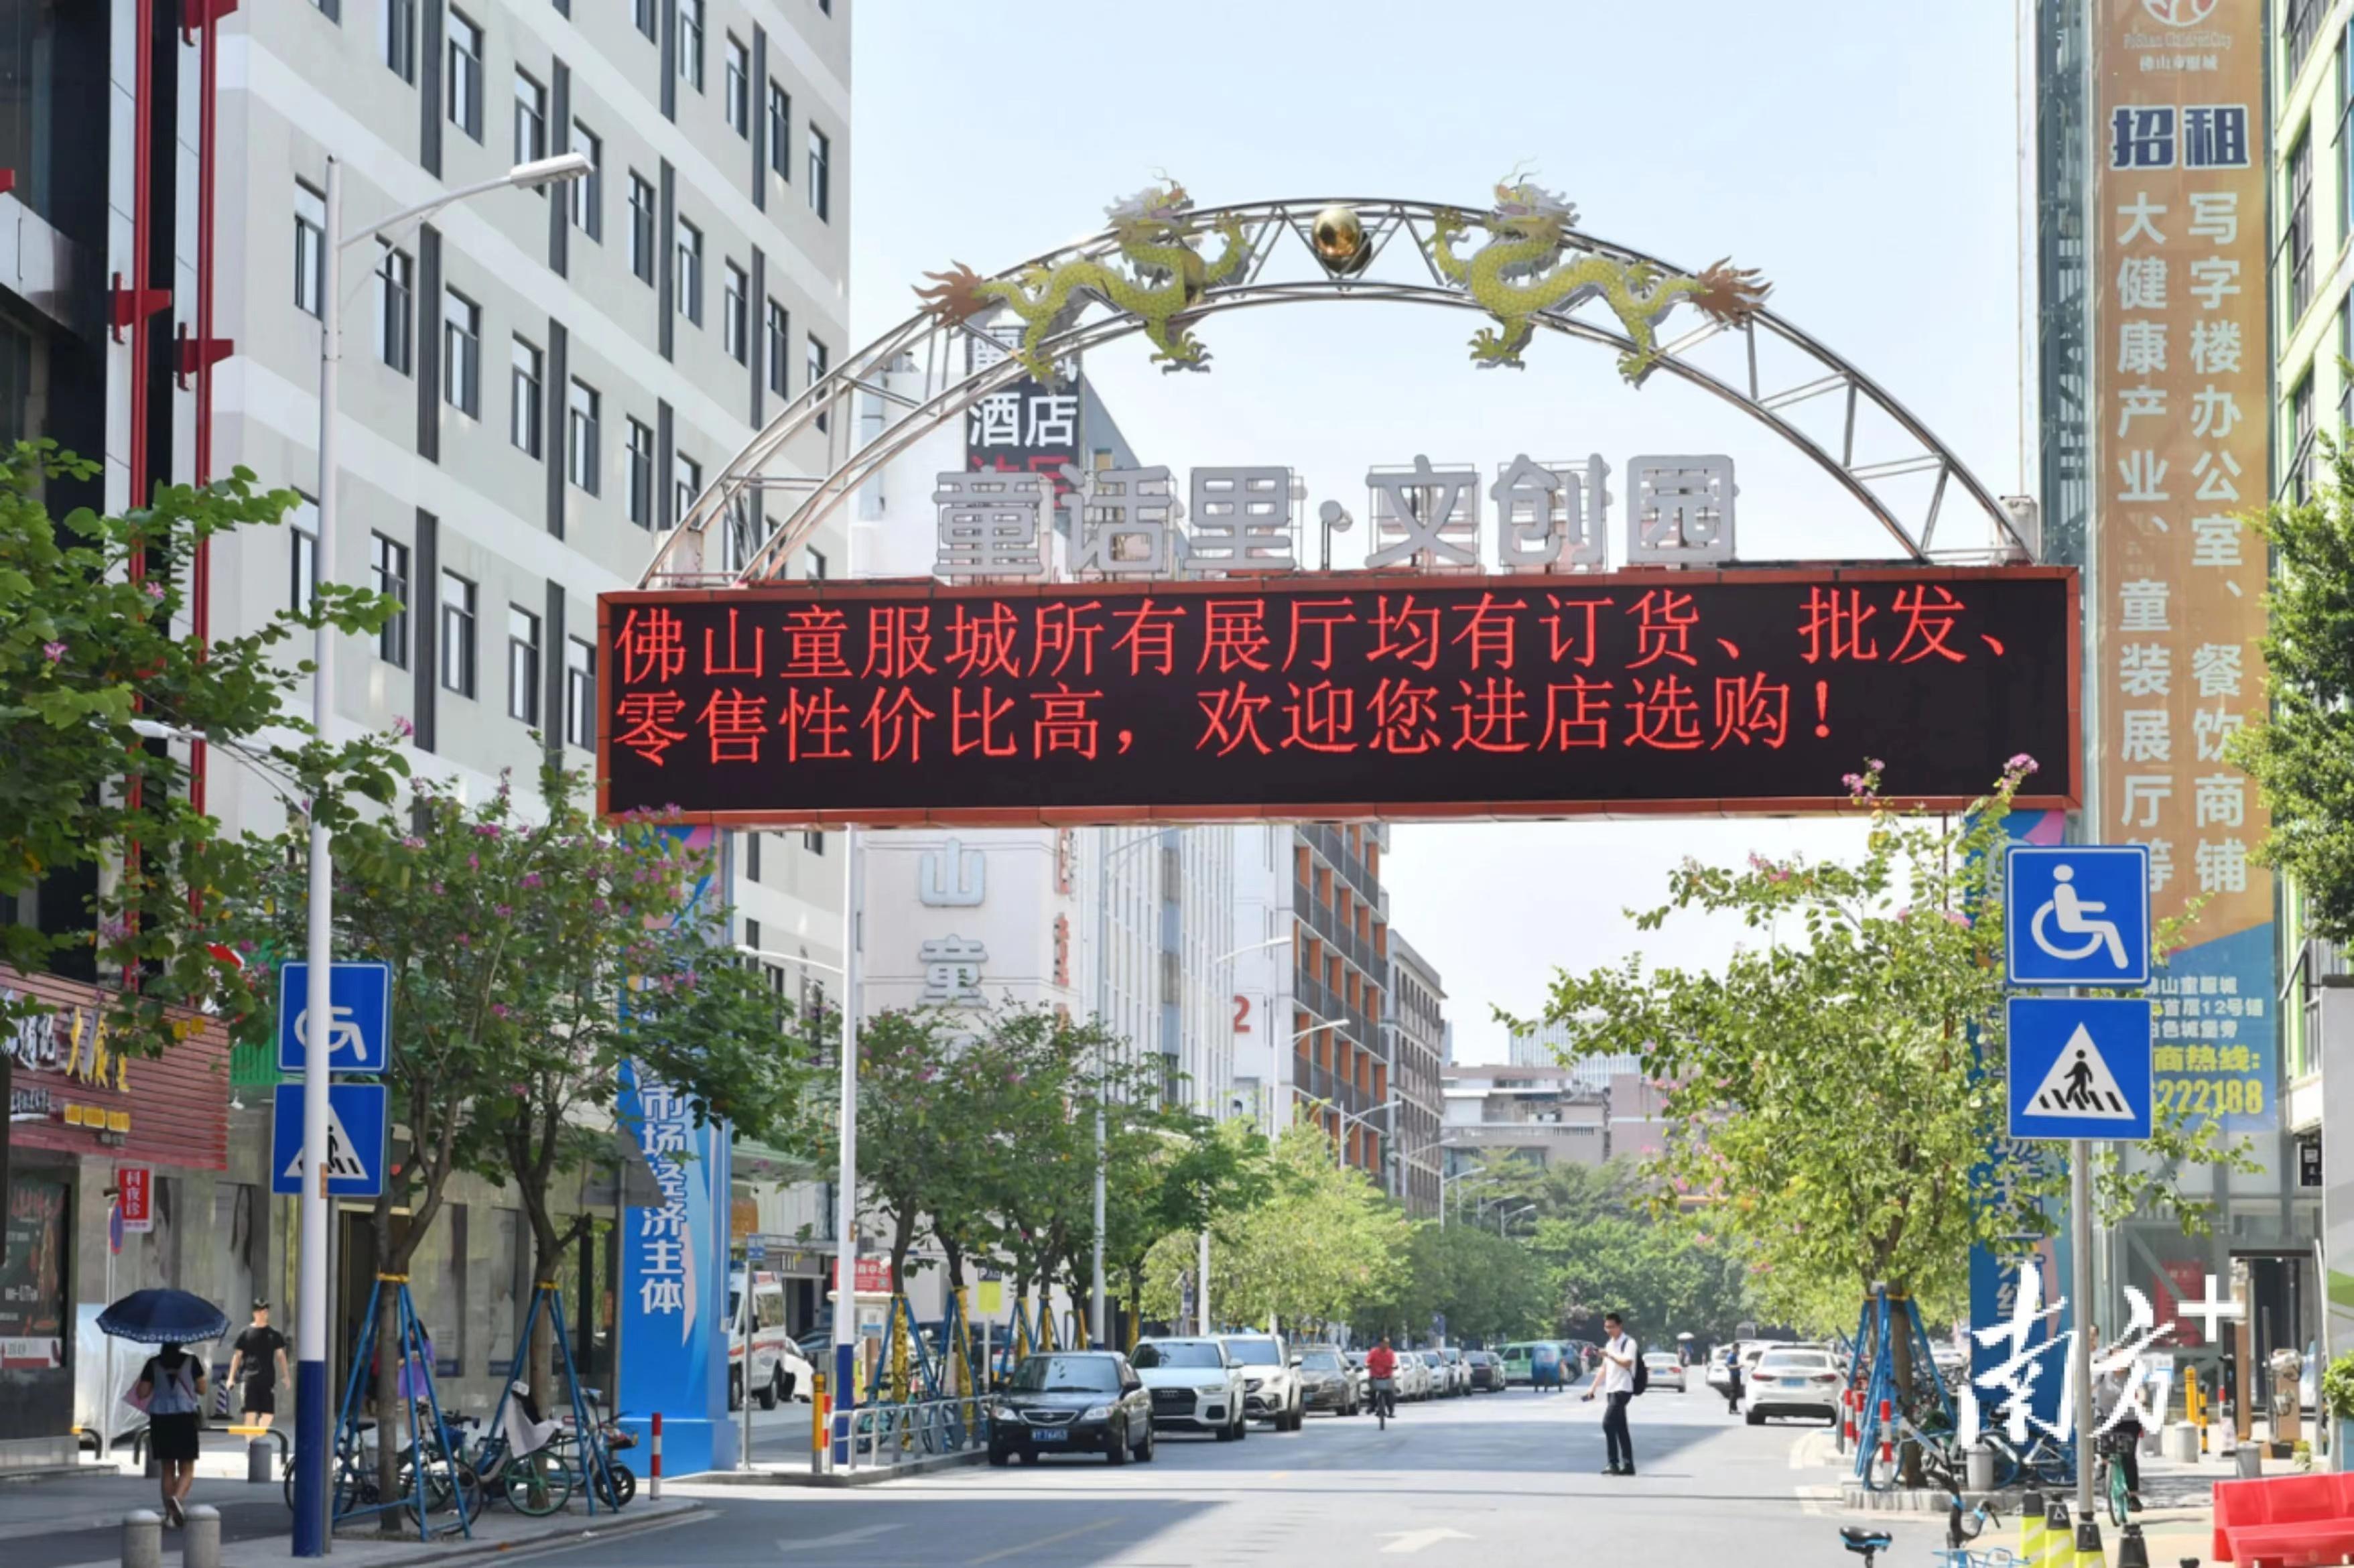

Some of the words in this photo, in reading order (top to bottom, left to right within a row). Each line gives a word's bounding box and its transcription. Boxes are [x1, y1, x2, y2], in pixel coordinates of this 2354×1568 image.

[2110, 105, 2250, 170] 招租
[969, 392, 1078, 448] 酒店
[932, 453, 1735, 576] 童话里·文创园
[1234, 995, 1251, 1033] 2
[2152, 997, 2264, 1017] 首层12号铺
[2152, 1078, 2263, 1114] 222188
[639, 1080, 685, 1314] 市场经济主体
